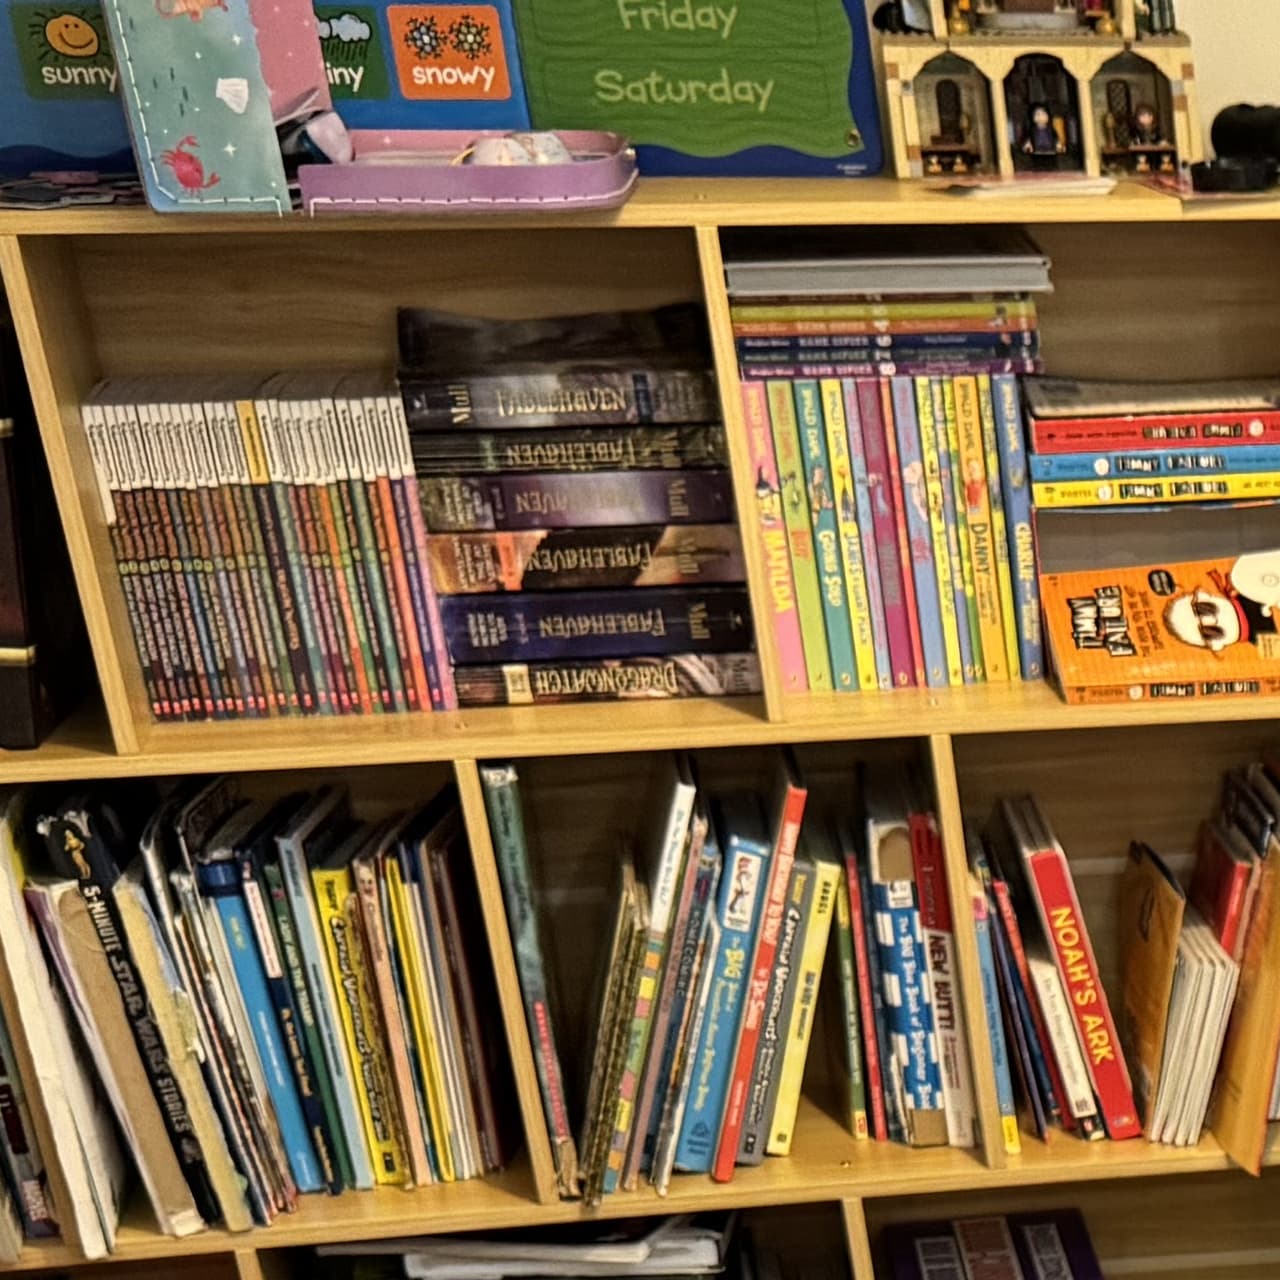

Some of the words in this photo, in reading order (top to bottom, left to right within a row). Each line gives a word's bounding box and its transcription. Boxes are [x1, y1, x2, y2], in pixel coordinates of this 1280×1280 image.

[619, 0, 738, 38] Friday
[411, 63, 496, 92] snowy
[593, 68, 776, 113] Saturday
[818, 530, 837, 573] GOING
[969, 523, 990, 576] DANNY
[762, 530, 795, 613] MATILDA
[539, 609, 666, 637] FABLEHAVEN
[1067, 597, 1104, 650] TIMMY
[1095, 584, 1138, 657] FAILURE
[536, 664, 678, 695] DRAGONWATCH
[278, 915, 295, 944] LADY
[899, 916, 909, 934] The
[286, 945, 301, 968] AND
[724, 948, 744, 978] BIG
[929, 934, 950, 976] NEW
[291, 969, 306, 990] THE
[1050, 905, 1099, 1008] NOAH'S
[1082, 1012, 1115, 1066] ARK
[83, 884, 122, 953] 5-MINUTE
[110, 953, 145, 1018] STAR
[136, 1015, 171, 1071] WARS
[156, 1076, 191, 1133] STORIES
[906, 987, 921, 1013] Book
[935, 981, 956, 1032] BUTT!
[911, 1016, 921, 1027] of
